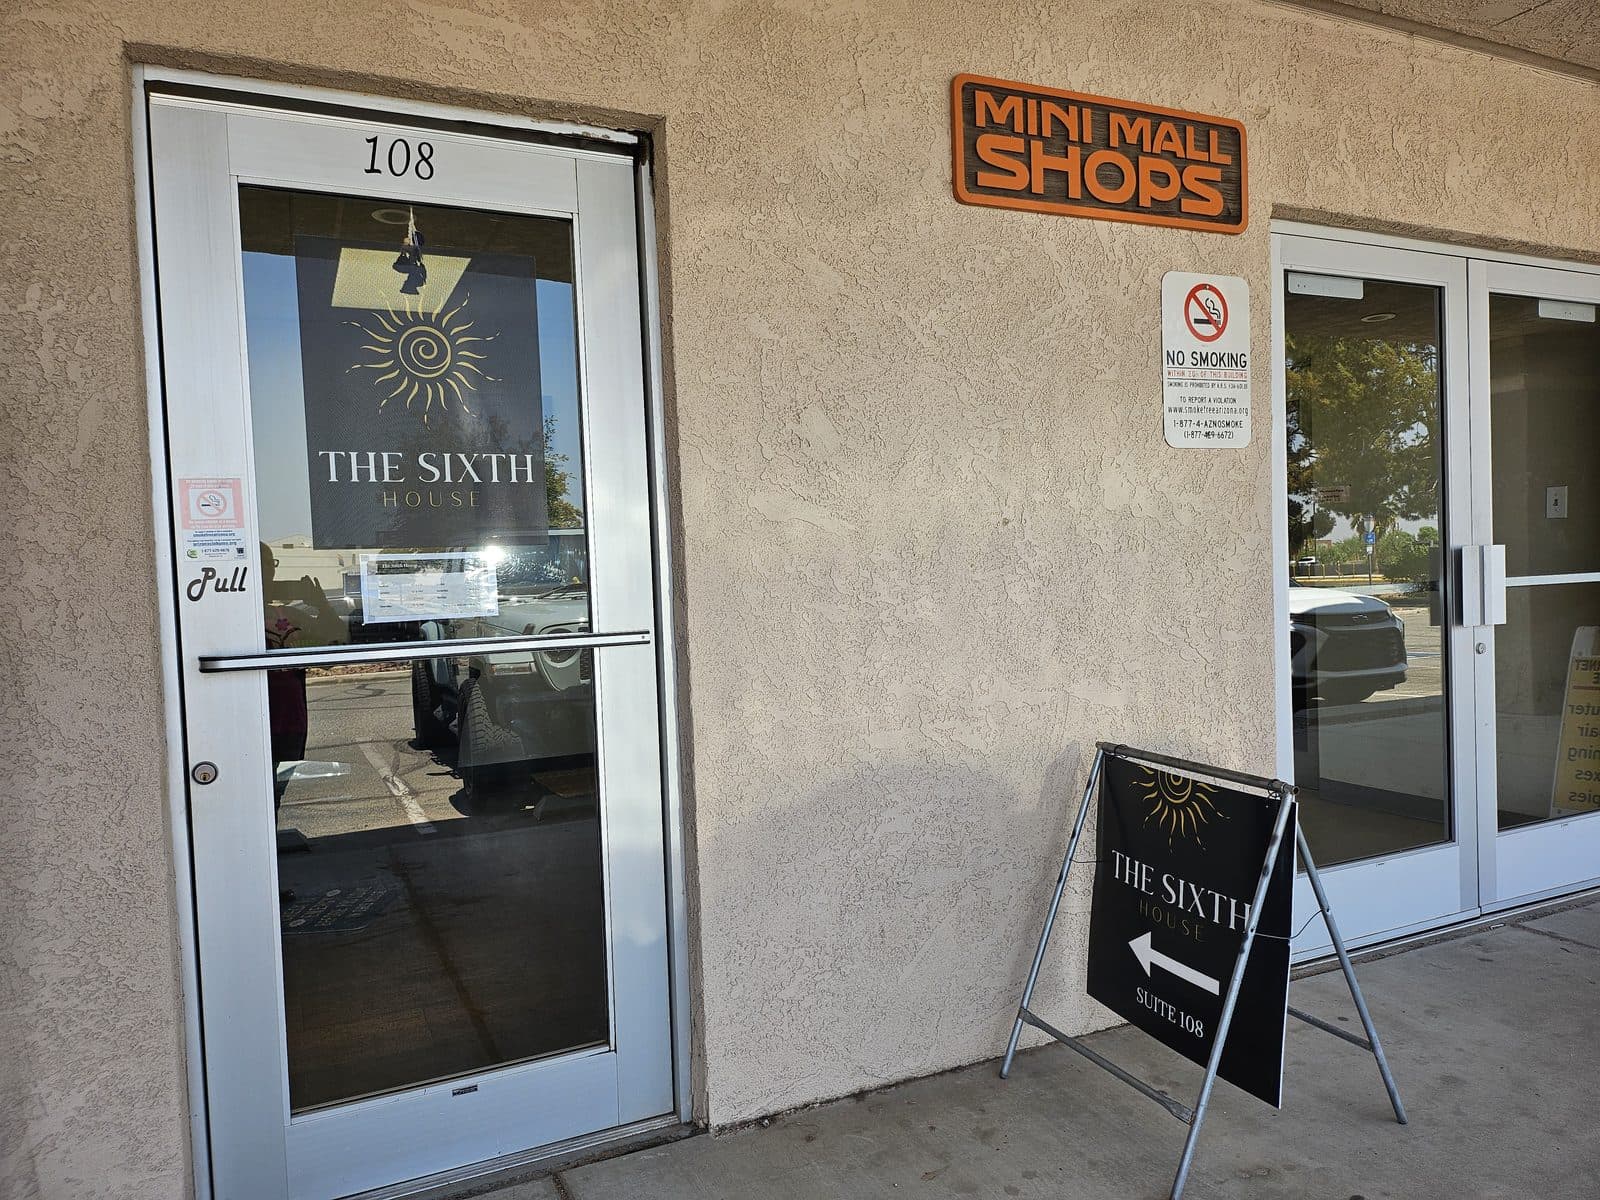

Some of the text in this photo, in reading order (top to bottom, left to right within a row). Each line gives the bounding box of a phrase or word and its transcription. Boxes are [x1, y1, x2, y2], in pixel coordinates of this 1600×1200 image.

[974, 90, 1232, 165] MINI MALL
[364, 135, 435, 181] 108
[975, 133, 1224, 217] SHOPS
[1166, 350, 1247, 368] NO SMOKING
[1168, 405, 1249, 417] www.smokefreearizona.org
[1179, 395, 1187, 404] TO
[1188, 396, 1207, 404] REPORT
[1173, 419, 1244, 429] 1-877-4-AZNOSMOKE
[318, 451, 534, 484] THE SIXTH
[383, 490, 481, 508] HOUSE
[186, 567, 248, 602] Pull
[1111, 849, 1251, 933] THE SIXTH
[1139, 899, 1204, 943] HOUSE
[1136, 986, 1204, 1038] SUITE 108
